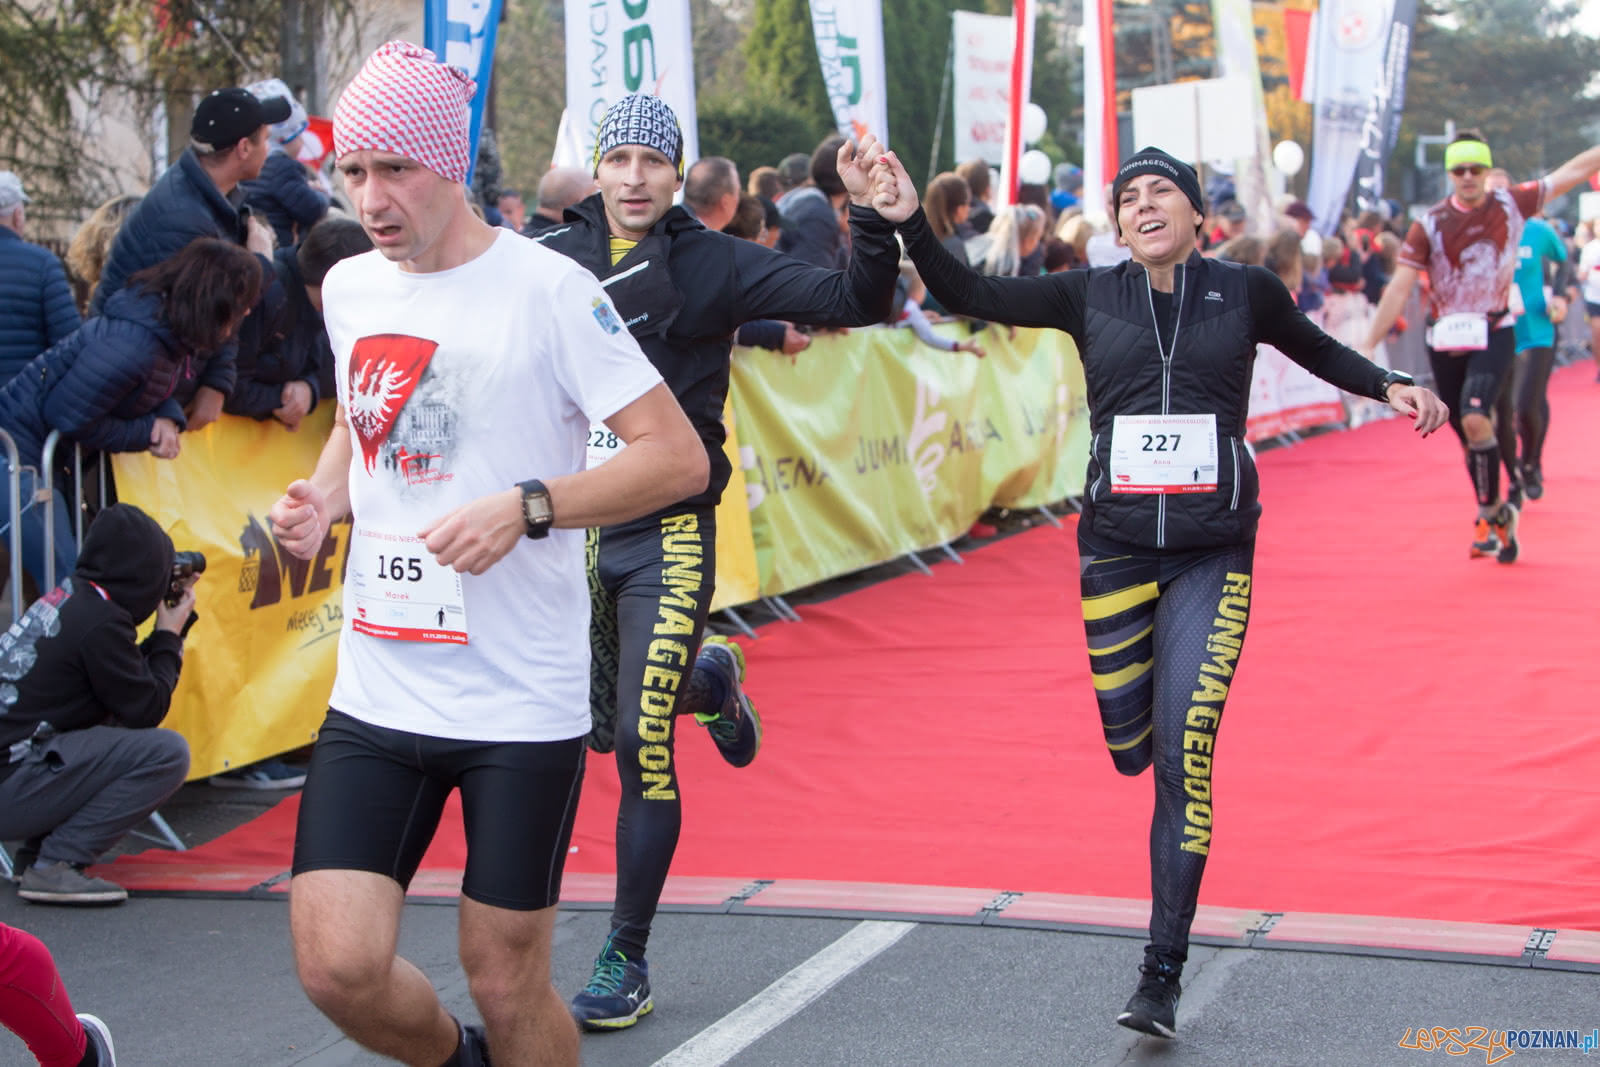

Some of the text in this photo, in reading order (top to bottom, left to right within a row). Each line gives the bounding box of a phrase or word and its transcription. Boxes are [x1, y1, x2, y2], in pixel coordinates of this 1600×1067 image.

[1141, 434, 1182, 452] 227
[378, 554, 423, 582] 165
[638, 513, 704, 801] RUNMAGEDDON
[1180, 571, 1251, 856] RUNMAGEDDON
